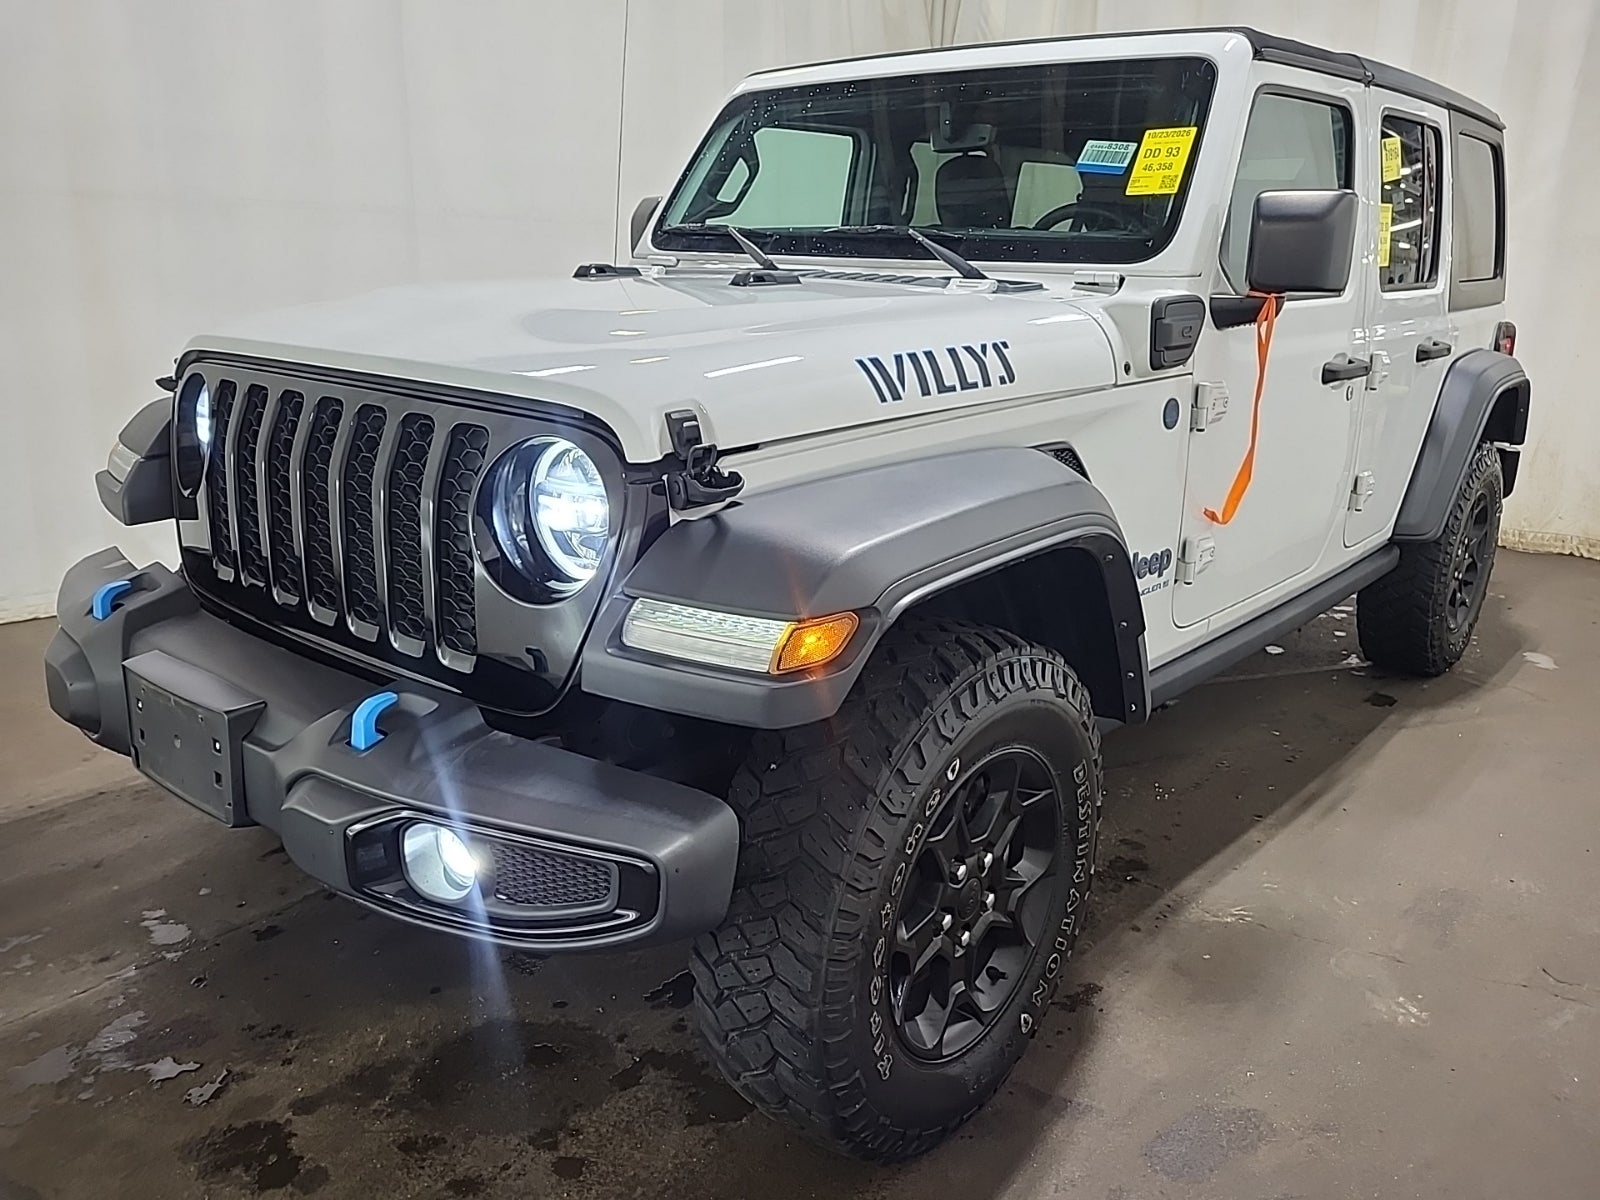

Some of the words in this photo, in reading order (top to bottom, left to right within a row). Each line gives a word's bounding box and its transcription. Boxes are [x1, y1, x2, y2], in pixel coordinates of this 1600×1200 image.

[1143, 148, 1161, 159] DD
[1165, 147, 1181, 158] 93
[854, 340, 1016, 404] WILLYS
[1031, 758, 1092, 1008] DESTINATION
